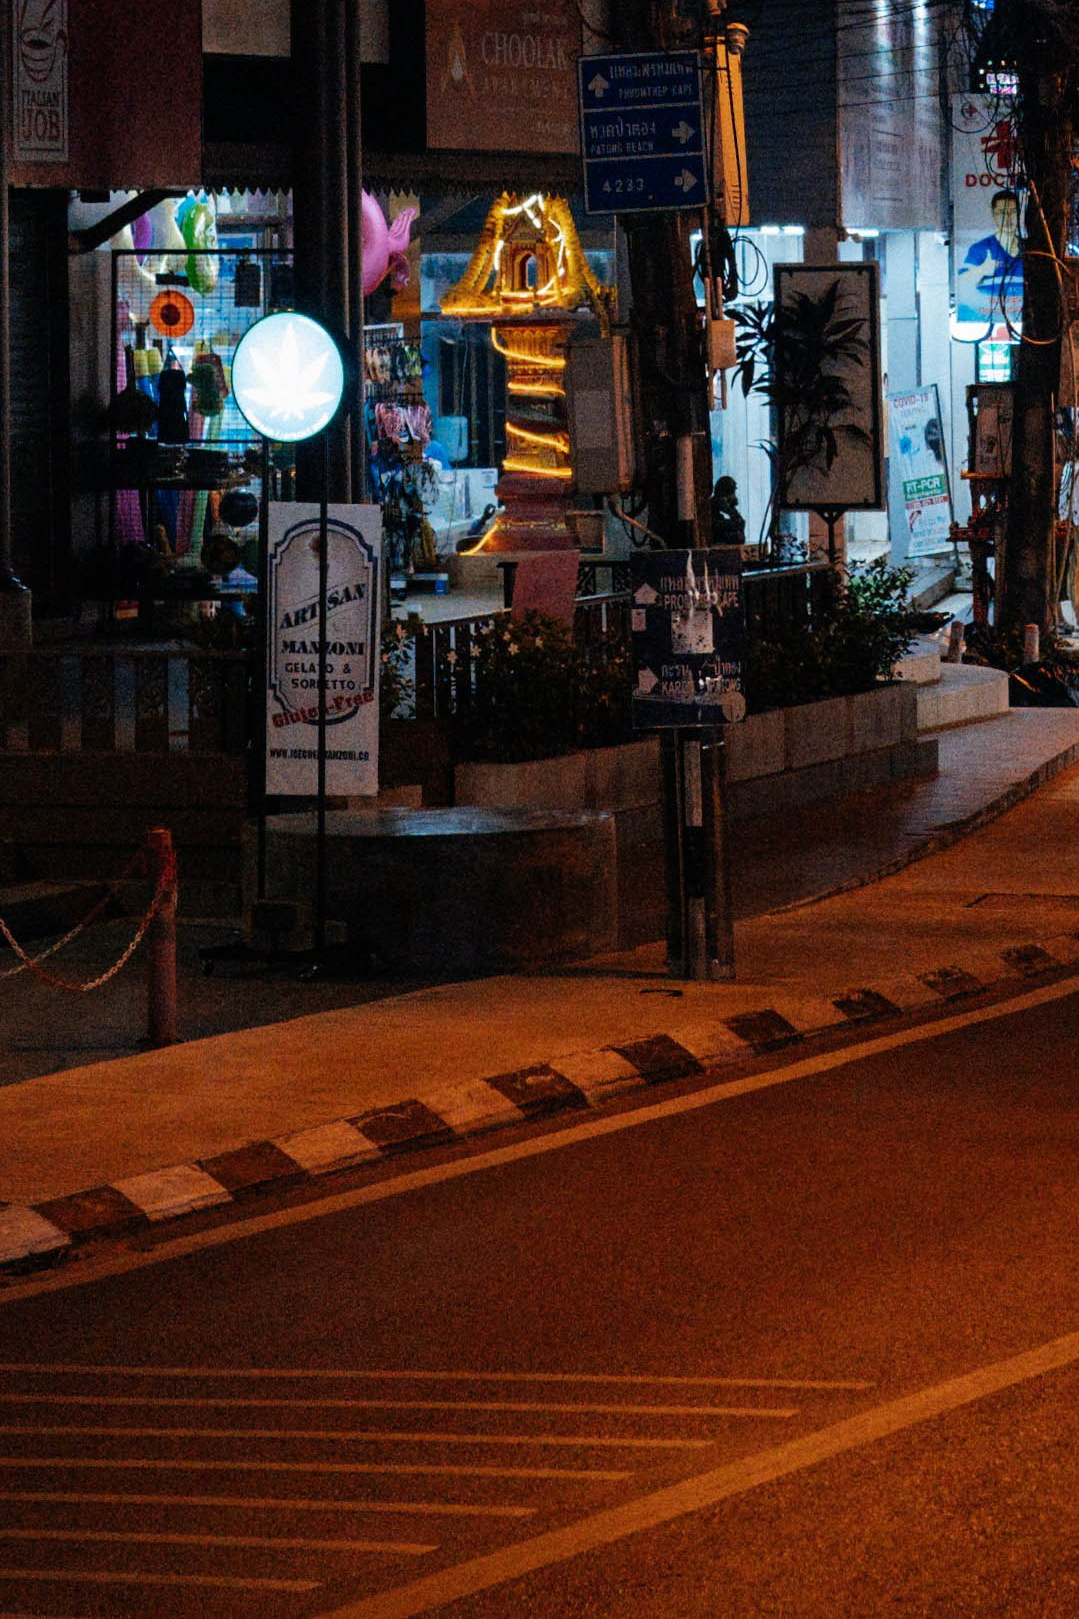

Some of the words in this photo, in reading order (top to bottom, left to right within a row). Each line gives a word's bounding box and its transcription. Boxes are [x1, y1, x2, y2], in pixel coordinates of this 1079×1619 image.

[22, 109, 60, 142] JOB
[626, 141, 655, 153] BEACH
[602, 178, 645, 193] 4233
[906, 478, 941, 494] RT-PCR
[280, 583, 366, 629] ARTSAN
[284, 662, 334, 674] GELAO
[343, 663, 352, 674] &
[291, 678, 356, 691] SORETTO
